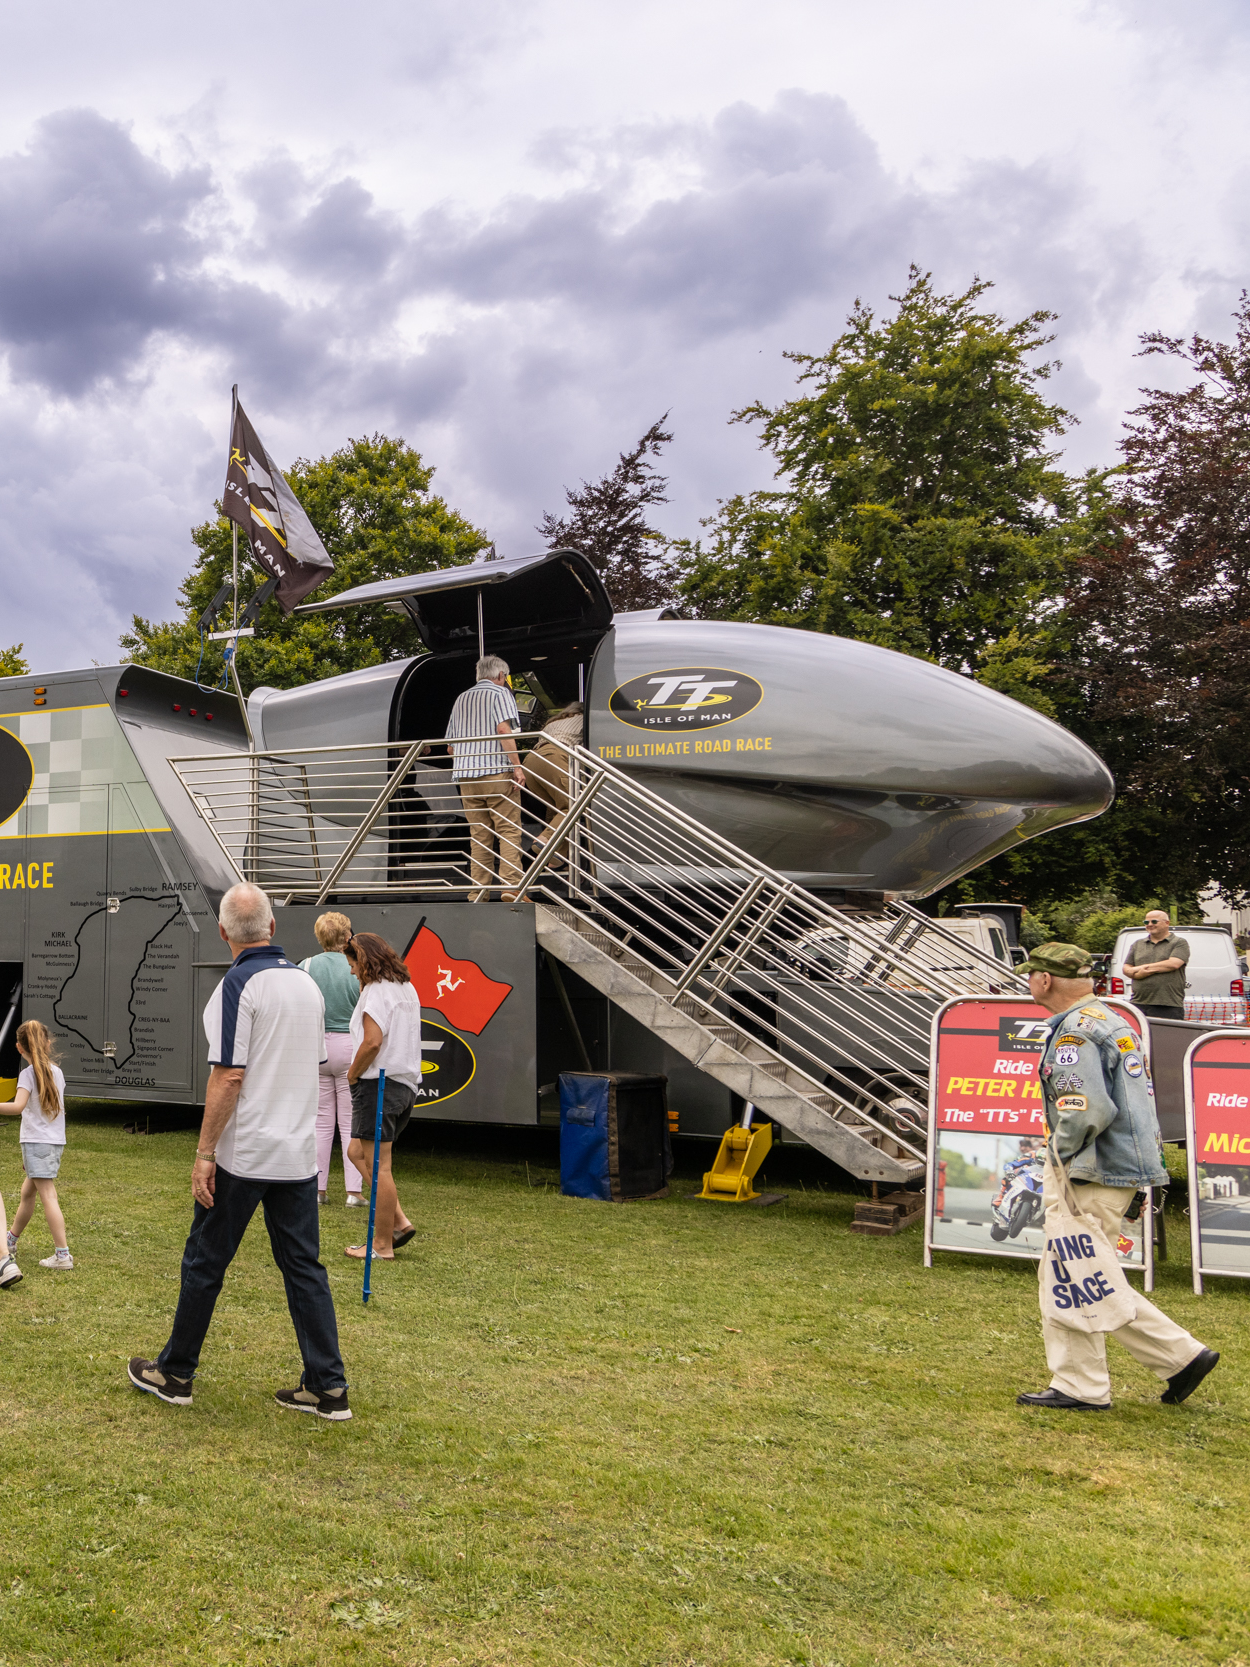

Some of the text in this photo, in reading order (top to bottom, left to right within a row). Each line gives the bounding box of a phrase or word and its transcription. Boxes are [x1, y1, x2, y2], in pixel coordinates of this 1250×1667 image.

[254, 539, 286, 578] MAN
[647, 674, 738, 711] TT
[598, 737, 772, 758] THE ULTIMATE ROAD RACE
[162, 882, 198, 890] RAMSEY
[993, 1059, 1034, 1075] Ride
[1060, 1054, 1073, 1064] 66
[114, 1076, 156, 1086] DOUGLAS
[946, 1076, 1018, 1098] PETER
[417, 1088, 440, 1097] AN
[1206, 1092, 1248, 1108] Ride
[944, 1108, 974, 1122] The
